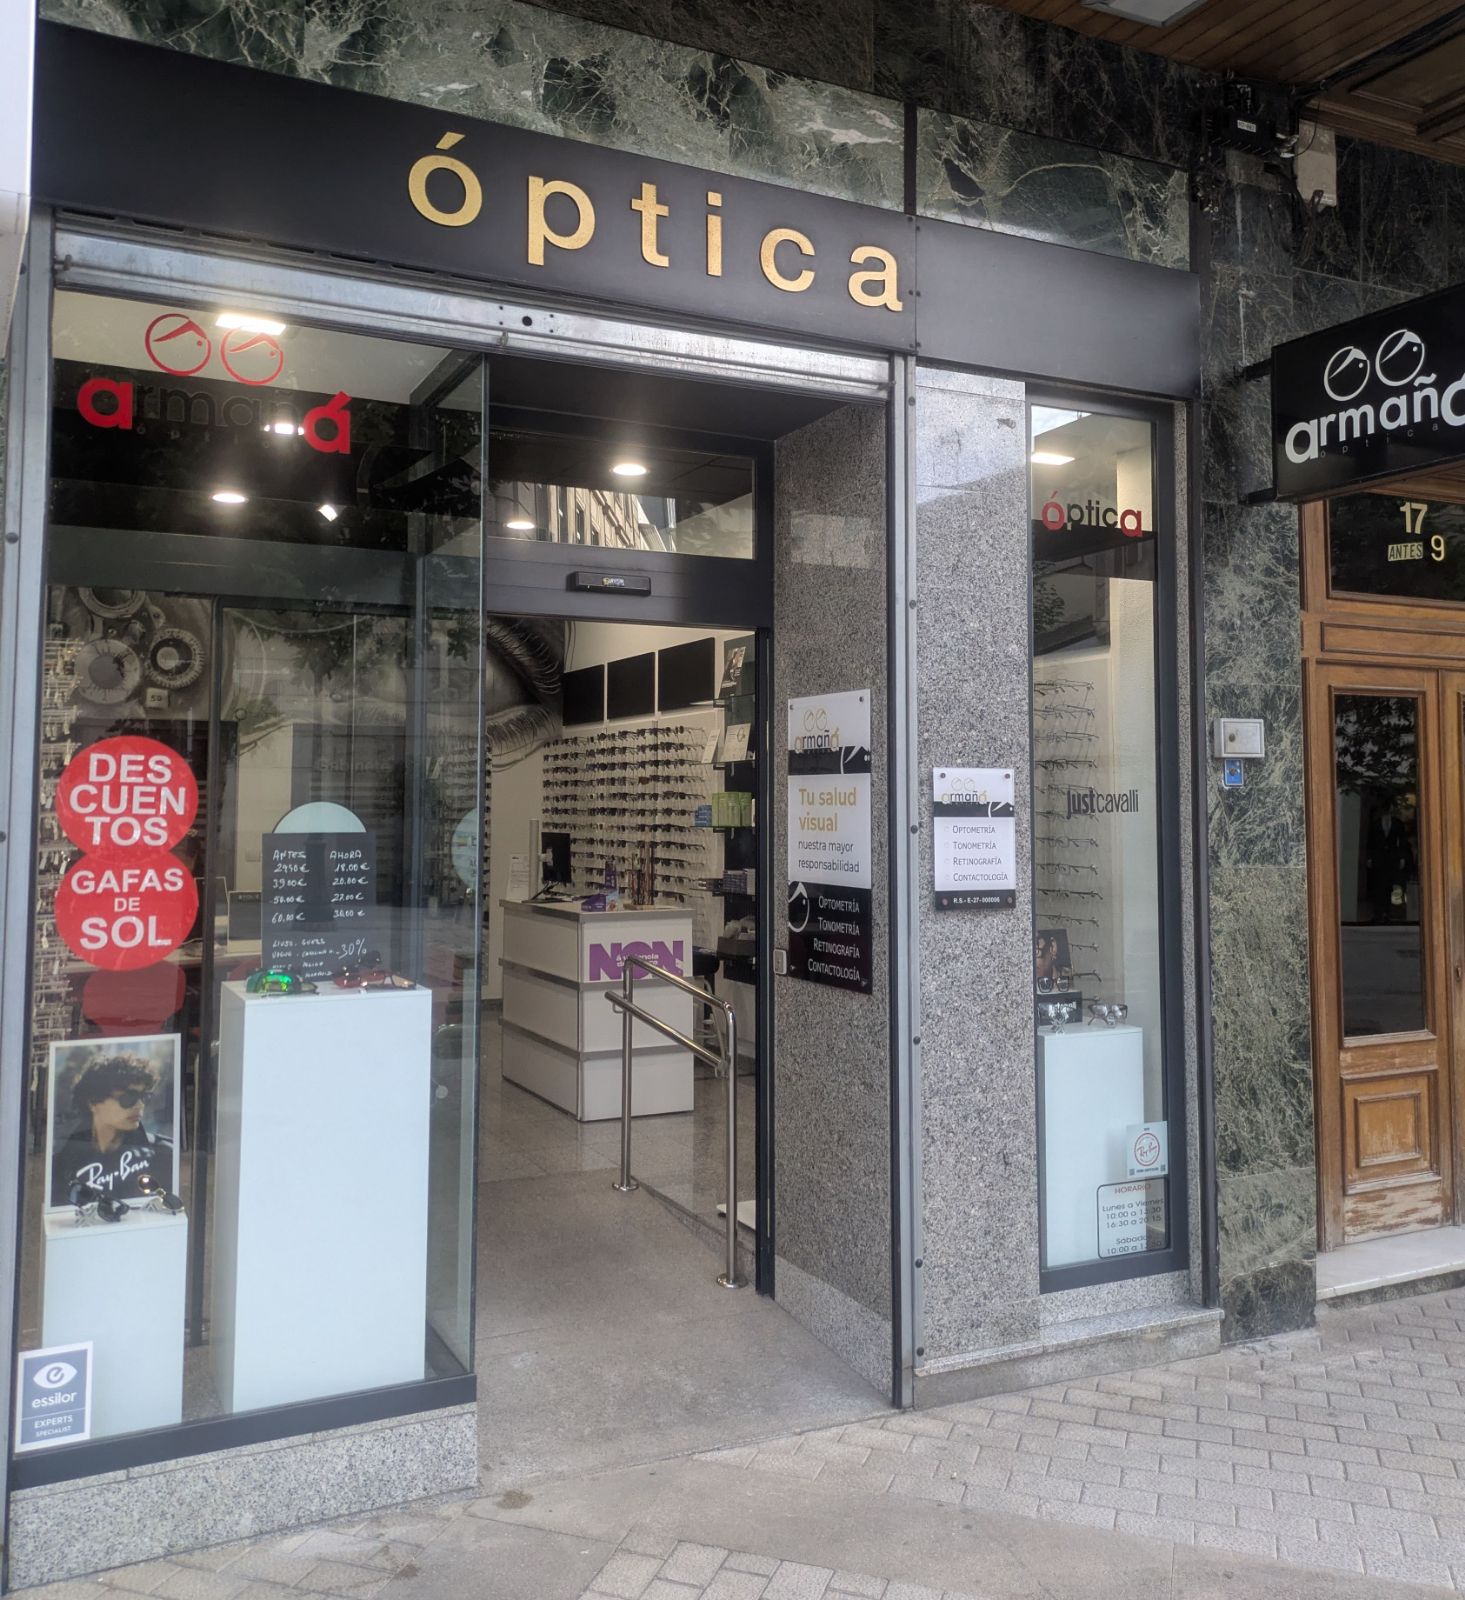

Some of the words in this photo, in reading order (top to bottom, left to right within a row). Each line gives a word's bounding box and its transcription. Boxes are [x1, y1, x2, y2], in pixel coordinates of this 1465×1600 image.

[408, 131, 903, 312] óptica
[1041, 490, 1143, 537] óptica
[1400, 502, 1428, 534] 17
[1389, 543, 1423, 560] ANTES
[1431, 535, 1445, 561] 9
[88, 753, 172, 784] DES
[70, 784, 186, 815] CUEN
[798, 788, 815, 806] Tu
[819, 787, 857, 806] salud
[85, 816, 168, 846] TOS
[799, 811, 838, 832] visual
[329, 849, 362, 859] AHORA
[798, 840, 827, 851] nuestra
[828, 842, 855, 855] mayor
[798, 859, 860, 873] responsabilidad
[70, 867, 184, 894] GAFAS
[113, 897, 141, 912] DE
[80, 915, 172, 949] SOL
[590, 940, 684, 981] NON
[76, 1151, 150, 1191] Ray-Ban
[1115, 1183, 1152, 1194] HORARIO
[1102, 1203, 1126, 1212] Lunes
[32, 1391, 78, 1408] essilor
[34, 1414, 73, 1429] EXPERTS
